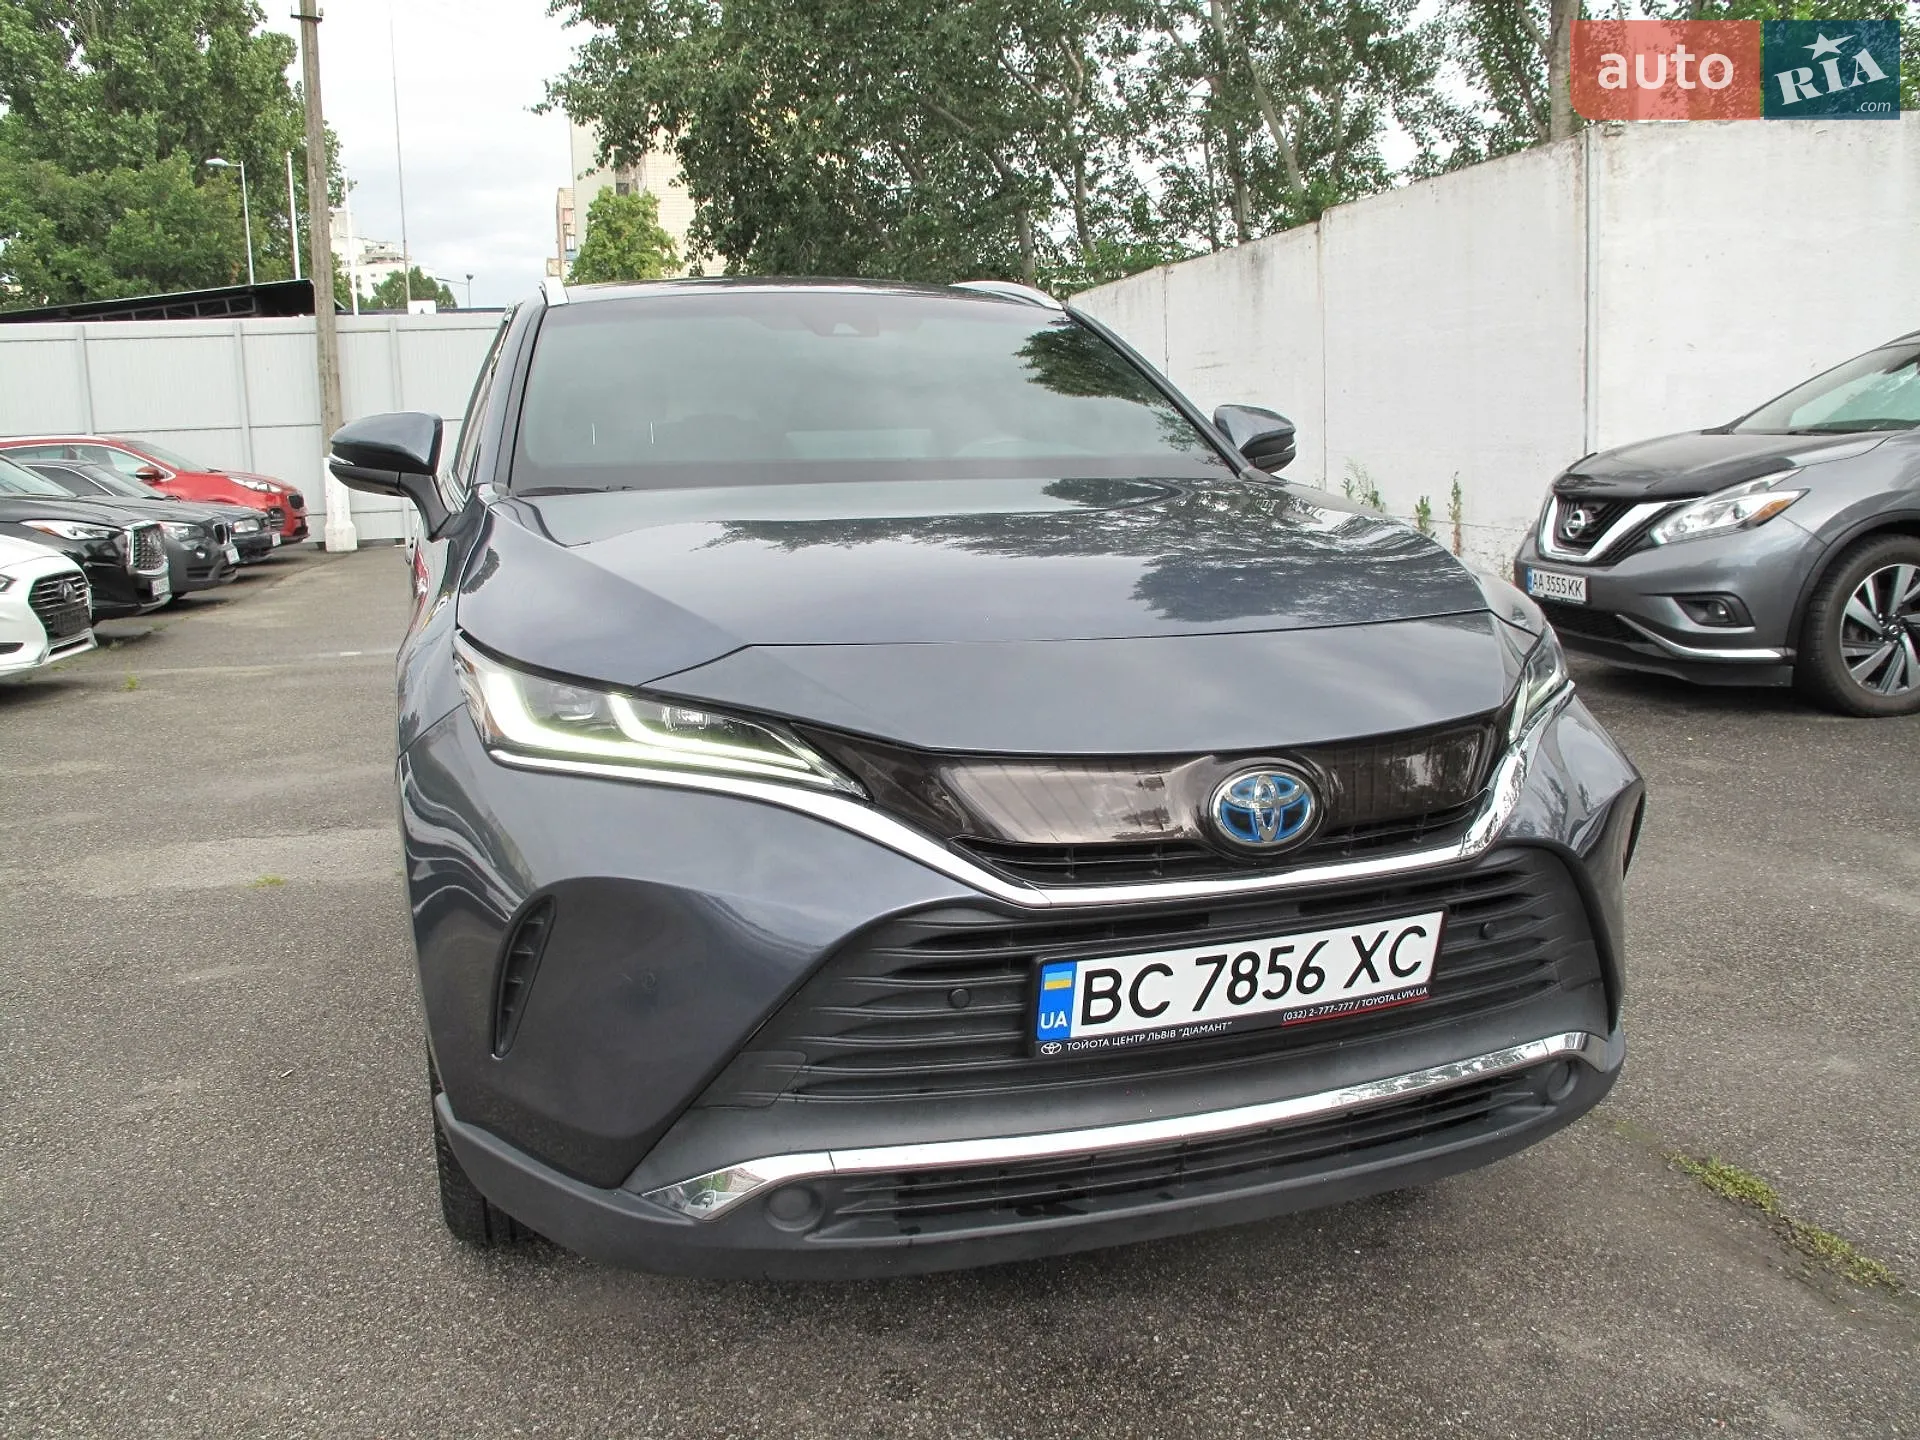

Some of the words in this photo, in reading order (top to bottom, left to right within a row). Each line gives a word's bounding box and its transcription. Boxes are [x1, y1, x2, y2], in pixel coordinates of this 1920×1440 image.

[1533, 573, 1544, 590] AA
[1547, 575, 1567, 594] 3555
[1568, 579, 1583, 598] KK
[1081, 963, 1174, 1026] BC
[1192, 940, 1330, 1012] 7856
[1343, 925, 1427, 989] XC
[1282, 1010, 1307, 1022] (032)
[1308, 1001, 1354, 1017] 2-777-777
[1361, 986, 1428, 1007] TOYOTA.LVIV.UA
[1041, 1012, 1068, 1029] UA
[1066, 1039, 1110, 1051] ТОЙОТА
[1112, 1035, 1145, 1047] ЦЕНТР
[1147, 1030, 1176, 1042] ЛЬВІВ
